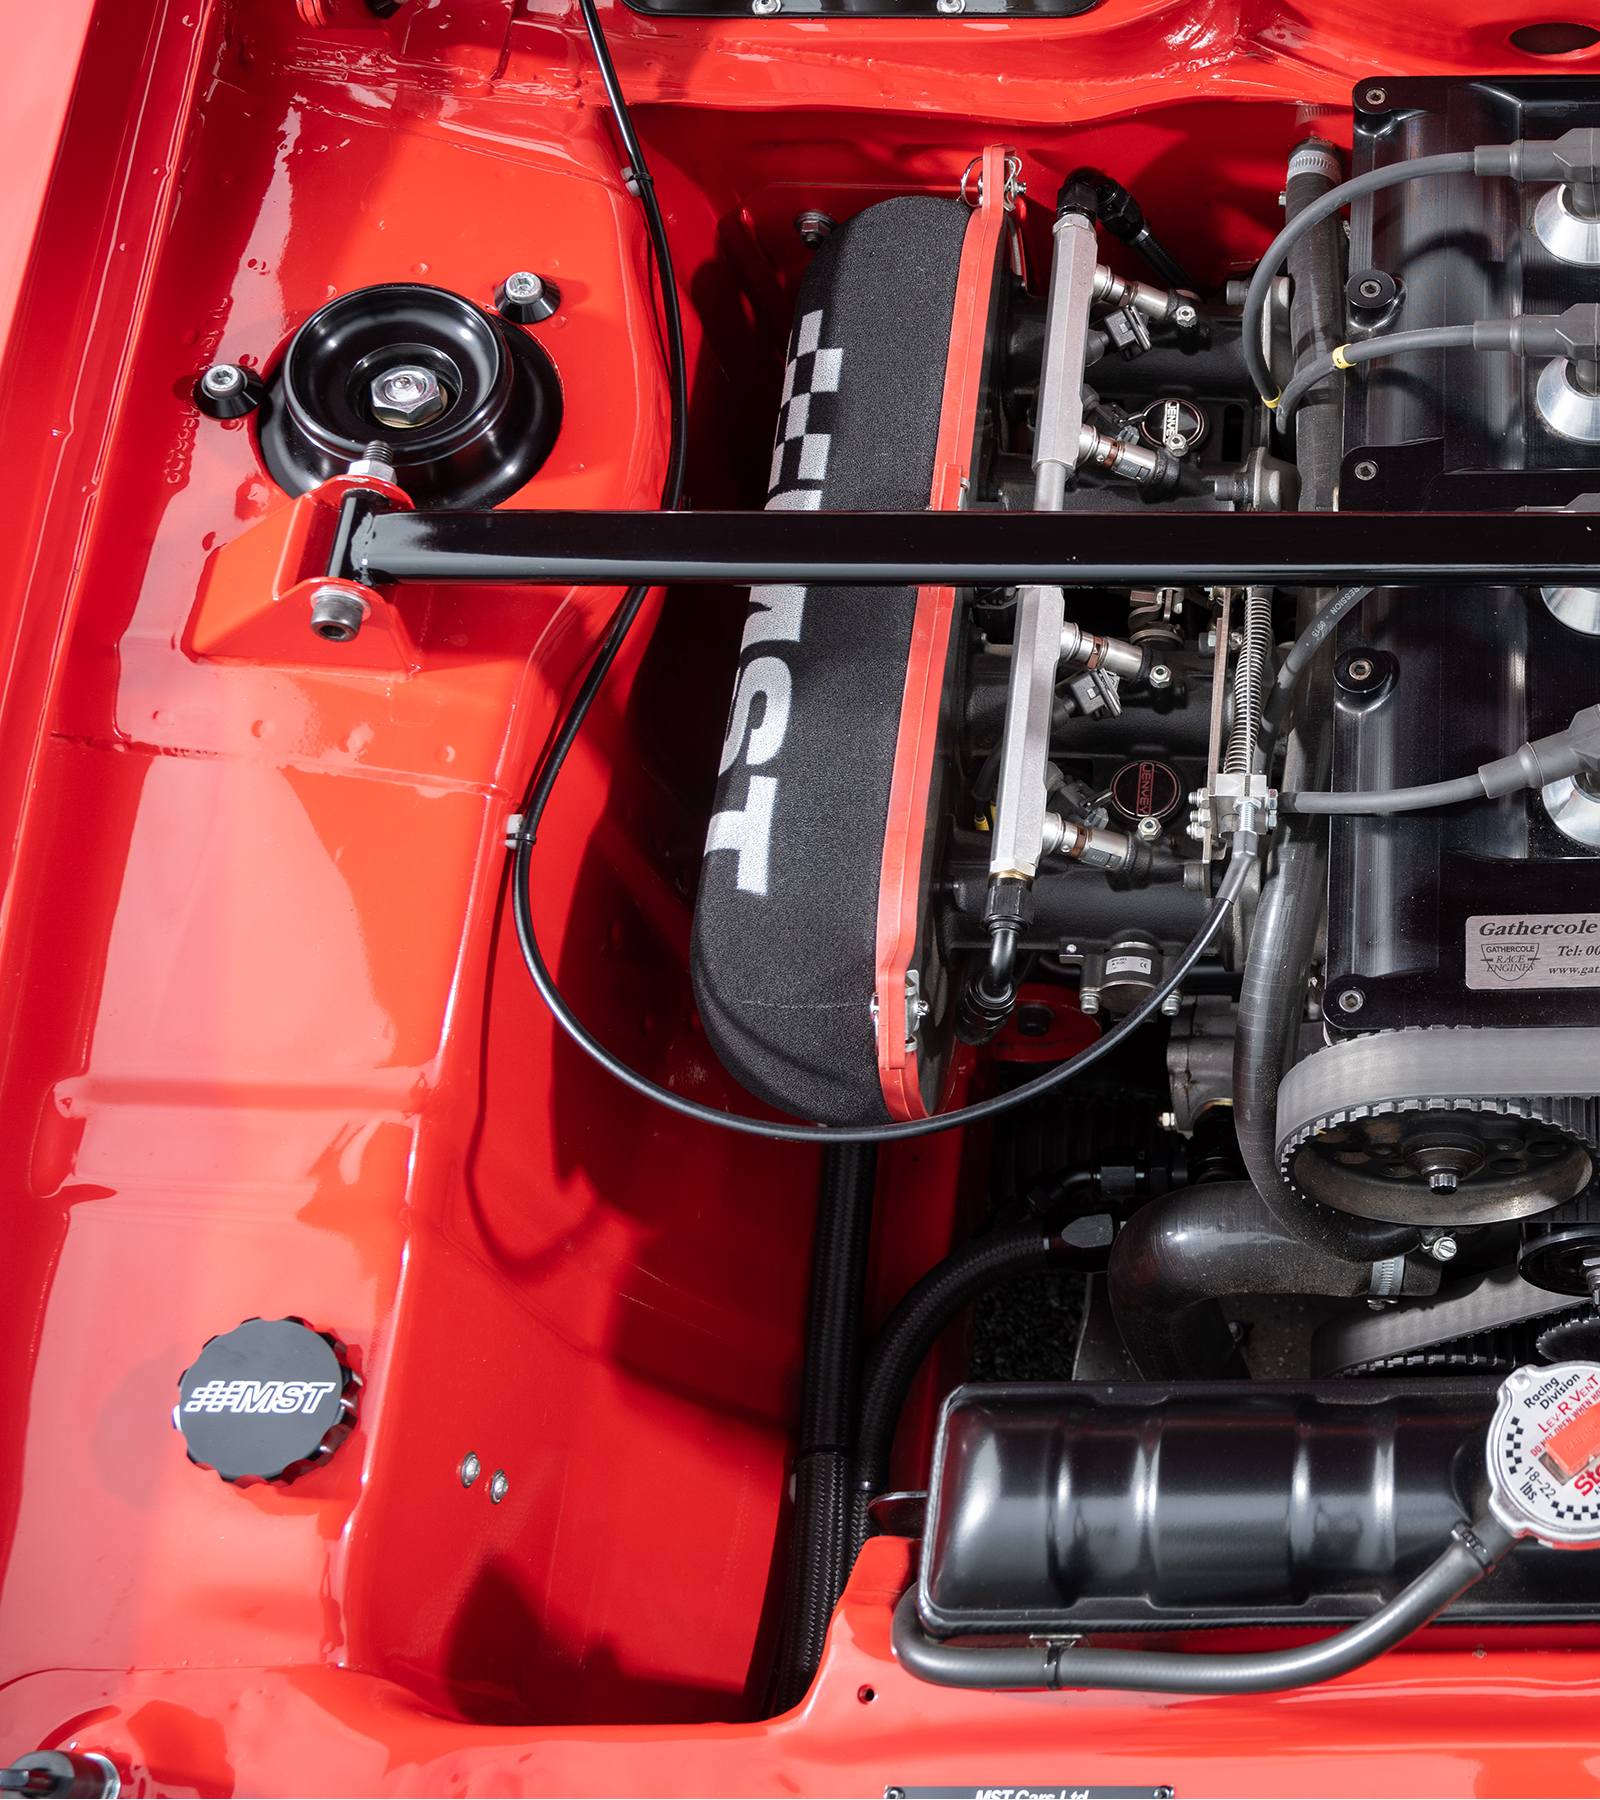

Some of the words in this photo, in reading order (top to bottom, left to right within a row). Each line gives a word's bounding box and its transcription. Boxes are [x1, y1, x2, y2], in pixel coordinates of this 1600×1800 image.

[1166, 402, 1177, 439] JENVE
[1330, 585, 1363, 615] RESSION
[1139, 764, 1151, 814] JENVEY
[1480, 919, 1598, 936] Gathercole
[1486, 945, 1535, 953] GATHERCOLE
[1496, 954, 1526, 963] RACE
[1557, 945, 1582, 957] Tel:
[1487, 963, 1535, 972] ENGINES
[229, 1380, 337, 1414] MST
[1523, 1377, 1560, 1409] Racing
[1540, 1374, 1580, 1410] Division
[1530, 1445, 1542, 1457] DO
[1573, 1399, 1593, 1420] WHEN
